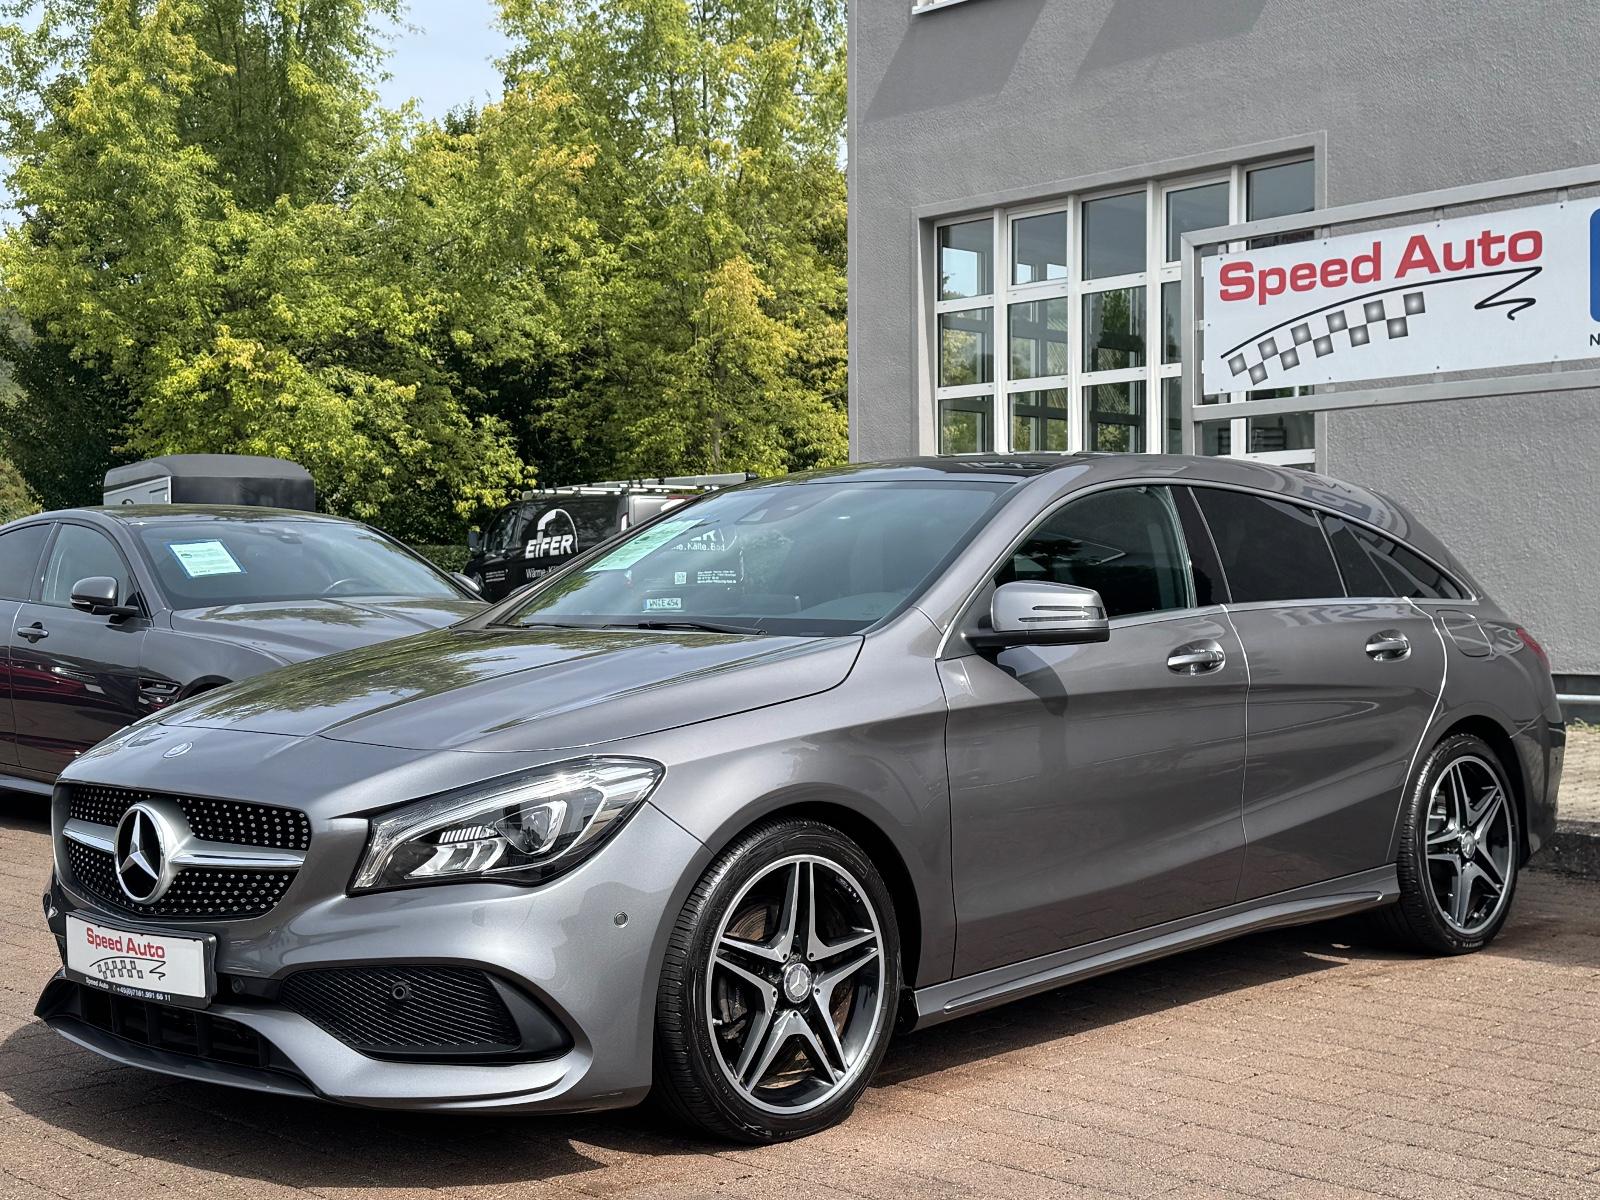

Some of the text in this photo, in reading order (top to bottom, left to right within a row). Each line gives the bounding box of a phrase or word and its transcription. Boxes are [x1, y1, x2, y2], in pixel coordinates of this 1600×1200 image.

[1219, 230, 1543, 305] Speed Auto
[86, 927, 165, 958] Speed Auto
